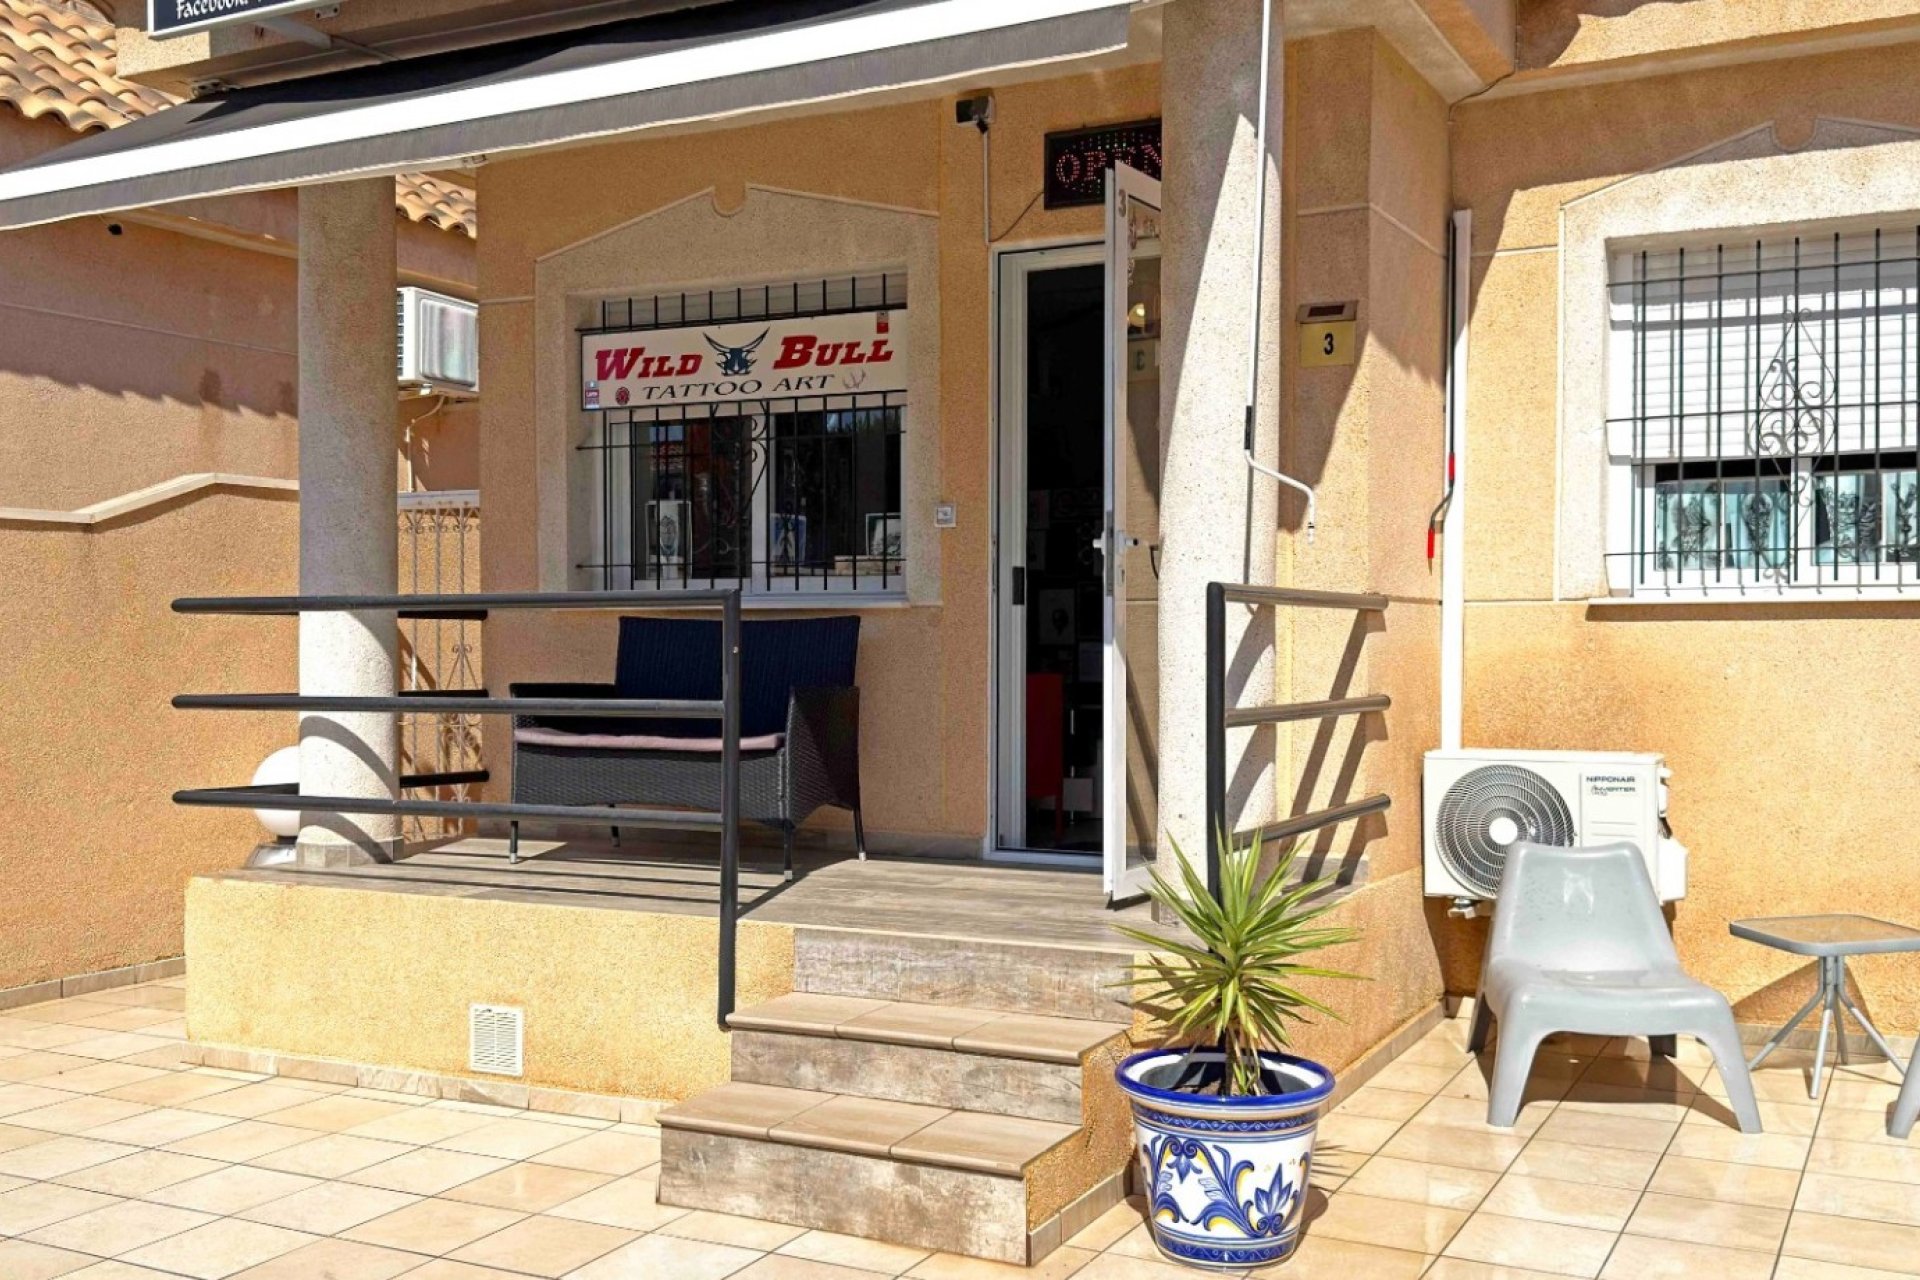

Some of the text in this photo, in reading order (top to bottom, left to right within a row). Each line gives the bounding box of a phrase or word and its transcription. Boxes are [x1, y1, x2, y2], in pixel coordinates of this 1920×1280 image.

[1323, 332, 1334, 356] 3
[595, 335, 894, 381] WILD BULL
[642, 379, 763, 400] TATTOO
[772, 373, 835, 391] ART
